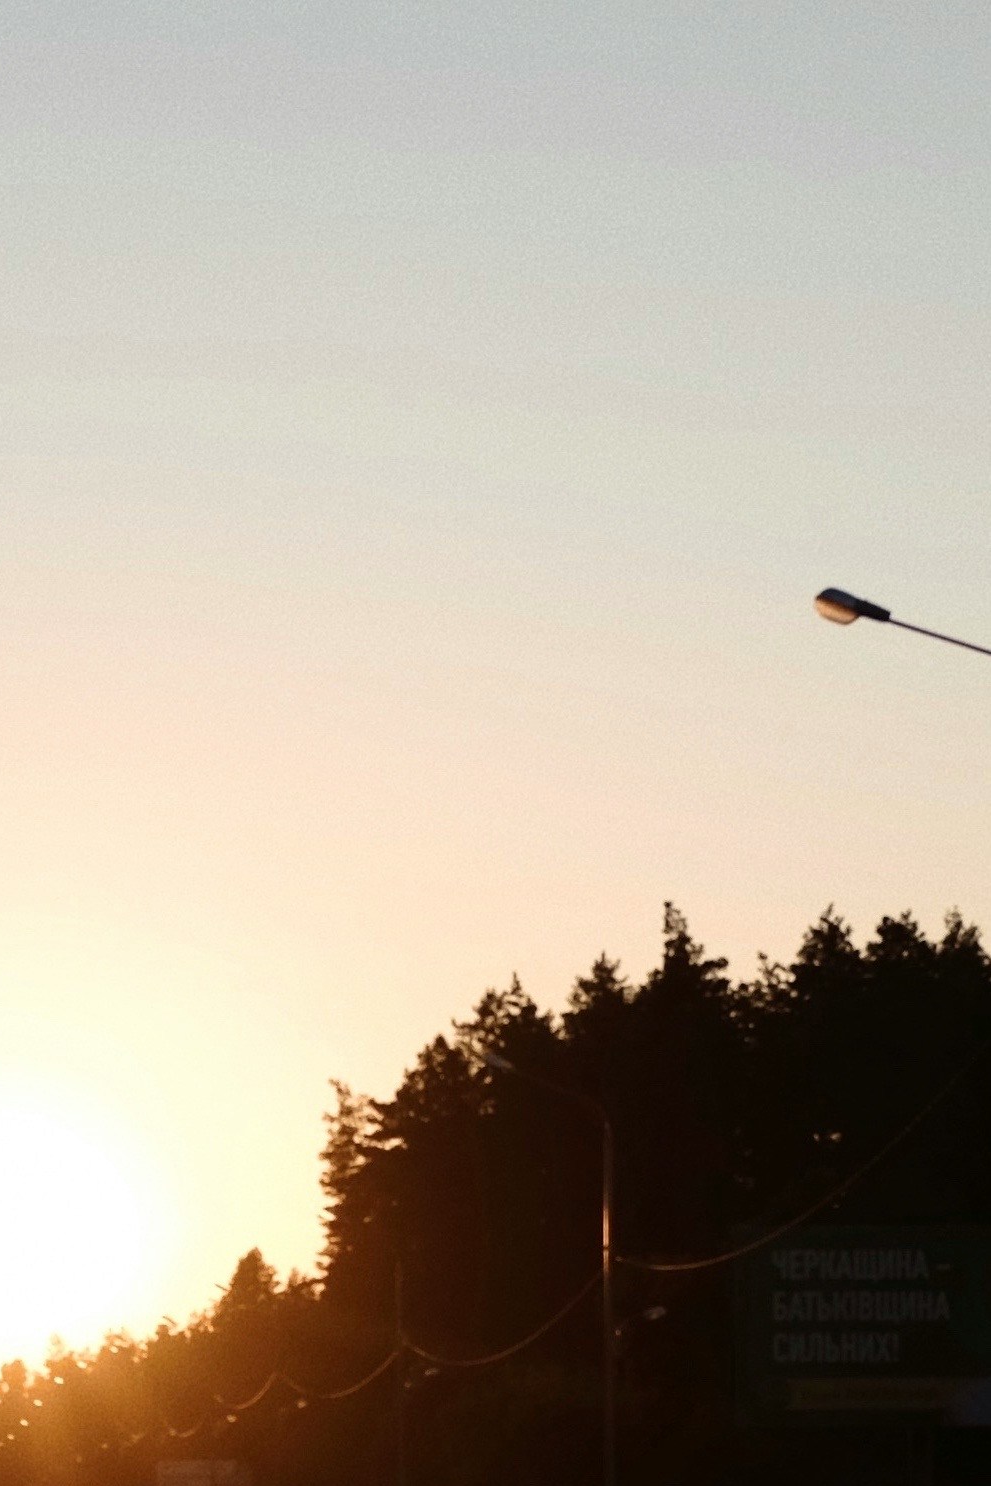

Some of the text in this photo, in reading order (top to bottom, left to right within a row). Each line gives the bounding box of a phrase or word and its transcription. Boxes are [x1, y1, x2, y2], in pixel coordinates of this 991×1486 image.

[773, 1248, 929, 1282] ЧЕРКАЩИНА
[773, 1290, 949, 1323] БАТЬКІВЩИНА
[773, 1332, 899, 1362] СИЛЬНИХ!
